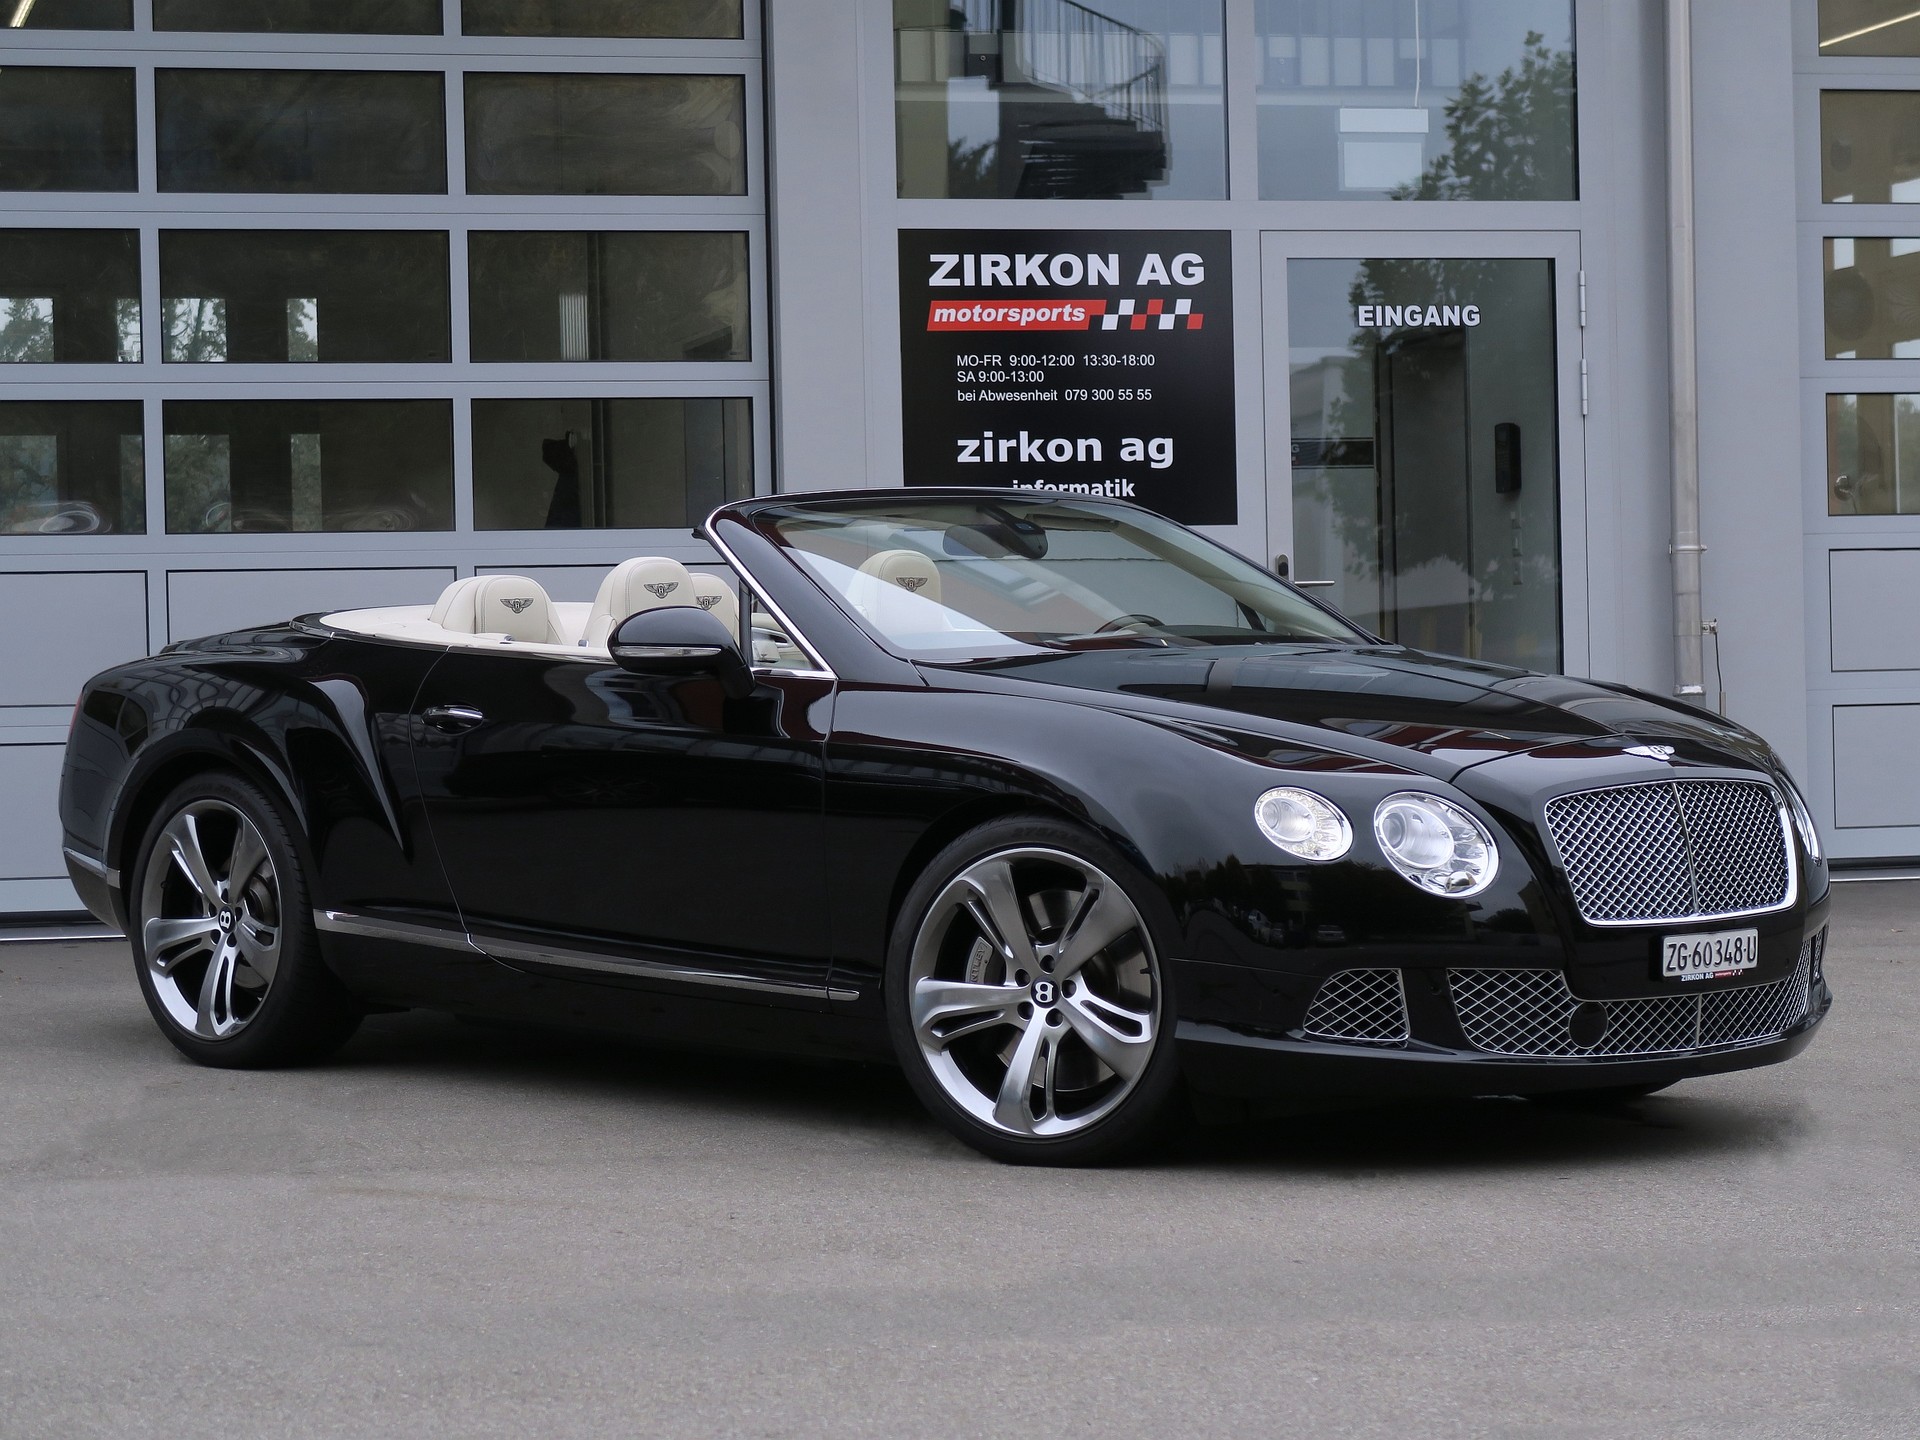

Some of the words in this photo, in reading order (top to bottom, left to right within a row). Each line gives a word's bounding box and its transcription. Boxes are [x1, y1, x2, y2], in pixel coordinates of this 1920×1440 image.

[928, 253, 1120, 287] ZIRKON
[1136, 253, 1205, 286] AG
[933, 303, 1086, 326] motorsports
[1358, 305, 1481, 327] EINGANG
[957, 355, 1002, 367] MO-FR
[1009, 354, 1075, 367] 9:00-12:00
[1083, 354, 1155, 367] 13:30-18:00
[957, 371, 976, 382] SA
[978, 370, 1045, 383] 9:00-13:00
[957, 389, 976, 402] bei
[979, 389, 1058, 402] Abwesenheit
[1064, 389, 1088, 401] 079
[1091, 389, 1115, 401] 300
[1118, 388, 1134, 401] 55
[1136, 388, 1152, 401] 55
[956, 430, 1103, 463] zirkon
[1119, 437, 1174, 469] ag
